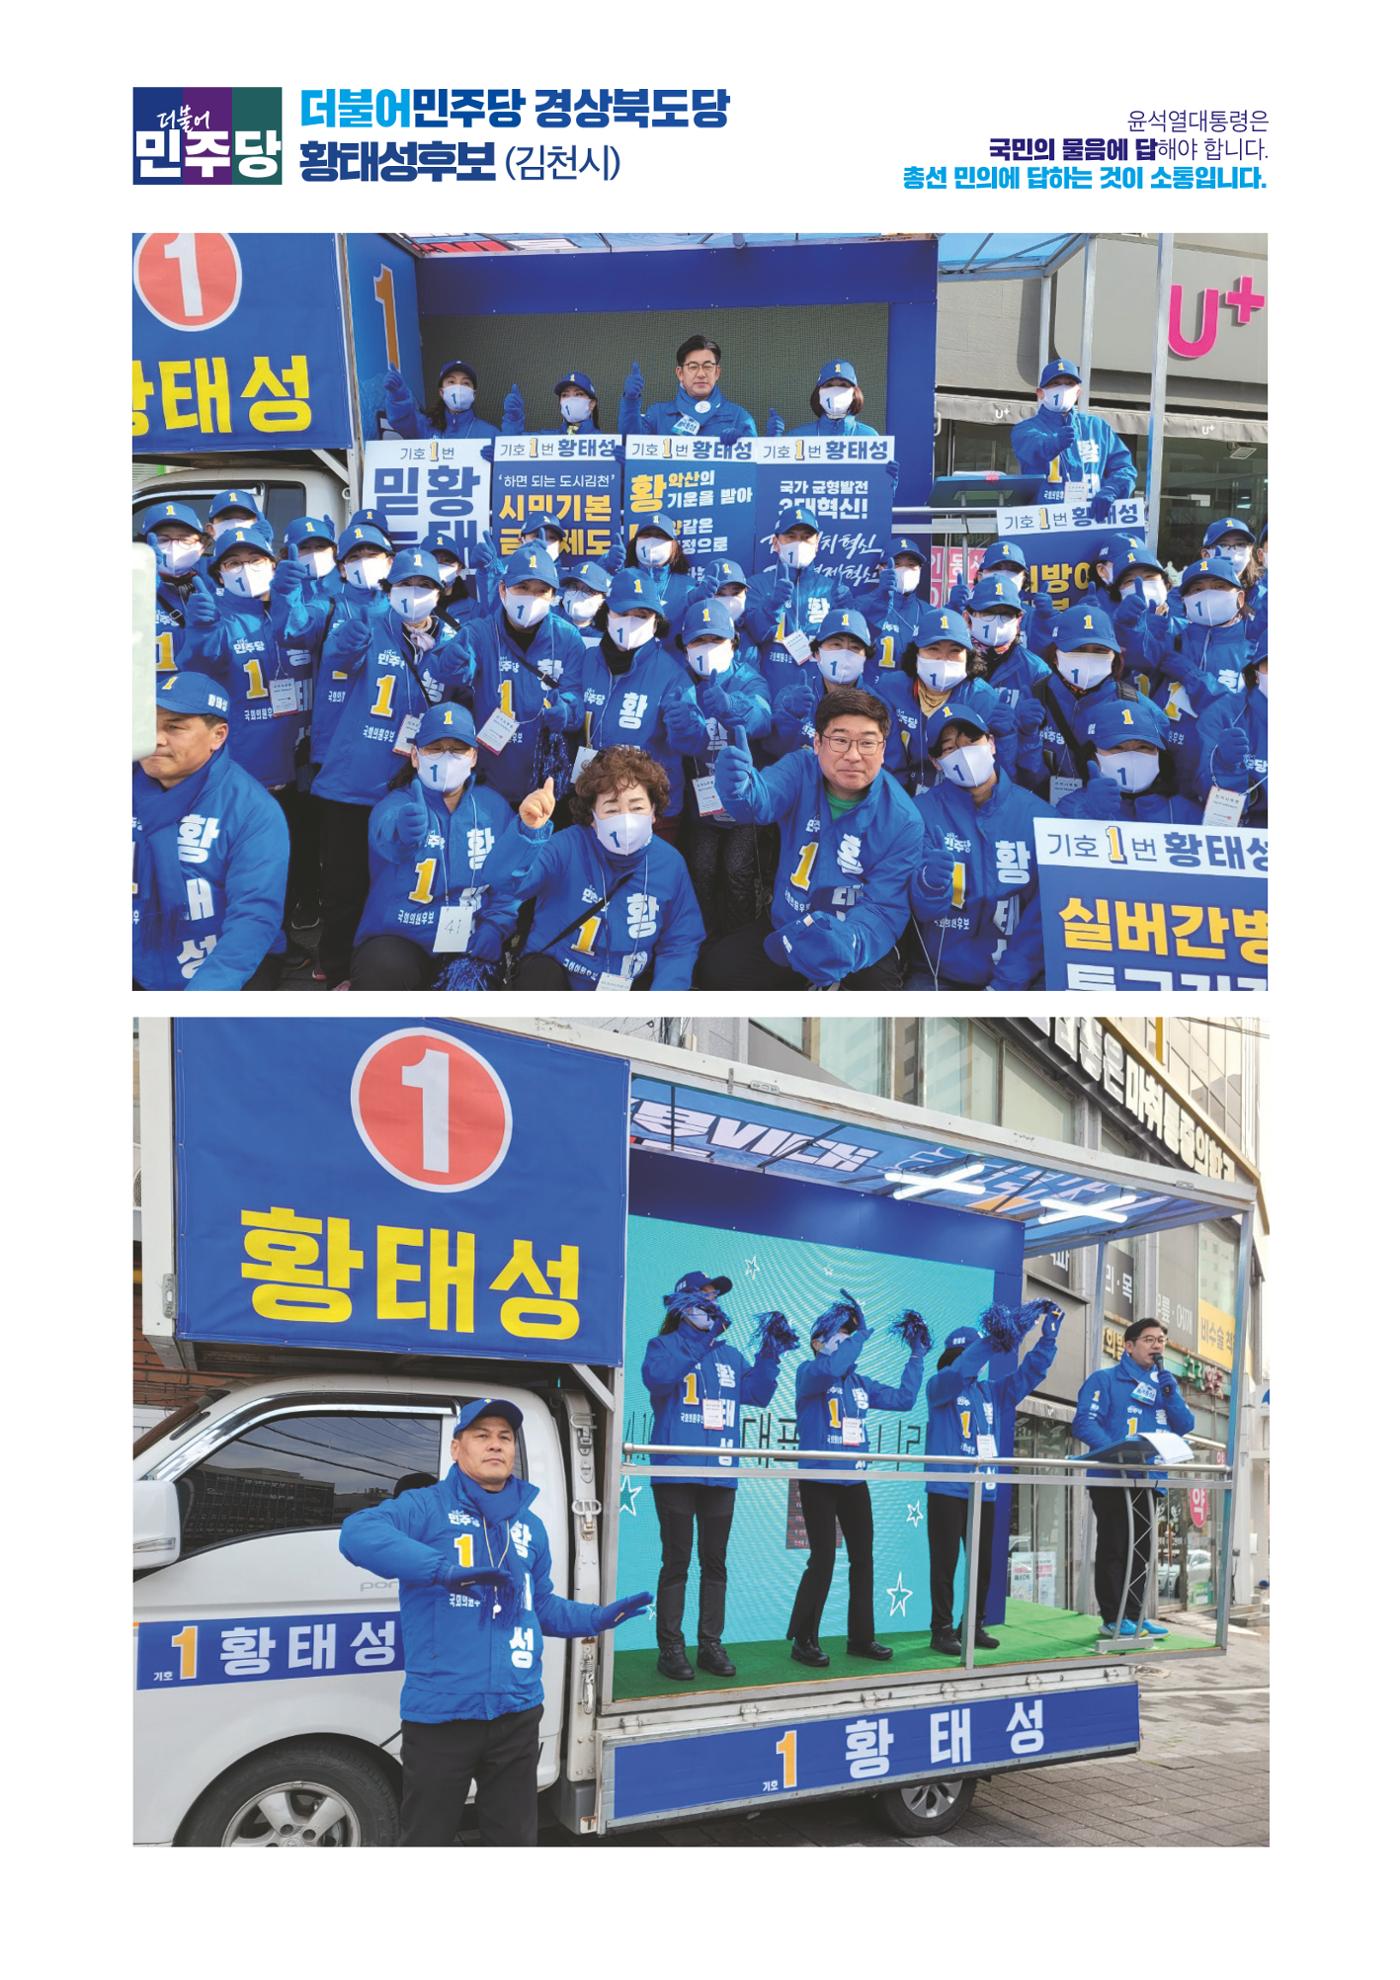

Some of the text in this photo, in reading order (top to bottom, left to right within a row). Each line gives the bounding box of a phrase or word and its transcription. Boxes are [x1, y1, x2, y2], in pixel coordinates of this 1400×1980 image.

[164, 233, 204, 317] 1
[1168, 275, 1265, 358] U+
[400, 441, 454, 462] 기호 1 번
[500, 438, 617, 458] 기호 1 번 황태성
[632, 438, 753, 460] 기호 1 번 황태성
[763, 439, 888, 460] 기호 1 번 황태성
[532, 476, 556, 488] 되는
[630, 469, 715, 513] 황 악산의
[667, 486, 753, 509] 기운을 받아
[779, 480, 869, 495] 국가 균형발전
[1004, 515, 1034, 529] 기호
[1039, 507, 1050, 530] 1
[1053, 513, 1068, 527] 번
[500, 528, 612, 556] 금제도
[681, 536, 728, 555] 정으로
[878, 635, 895, 668] 1
[243, 659, 269, 700] 1
[370, 674, 396, 718] 1
[619, 692, 648, 730] 황
[1047, 832, 1100, 859] 기호
[1105, 825, 1128, 864] 1
[1131, 837, 1157, 862] 번
[408, 857, 437, 904] 1
[790, 842, 819, 891] 1
[625, 892, 660, 939] 황
[571, 915, 602, 956] 1
[401, 1047, 450, 1173] 1
[240, 1206, 580, 1341] 황태성
[683, 1373, 699, 1405] 1
[828, 1398, 841, 1428] 1
[960, 1410, 972, 1438] 1
[1127, 1417, 1138, 1435] 1
[454, 1533, 474, 1568] 1
[153, 1621, 396, 1682] 기호 1 황태성
[762, 1780, 779, 1792] 기호
[776, 1730, 798, 1788] 1
